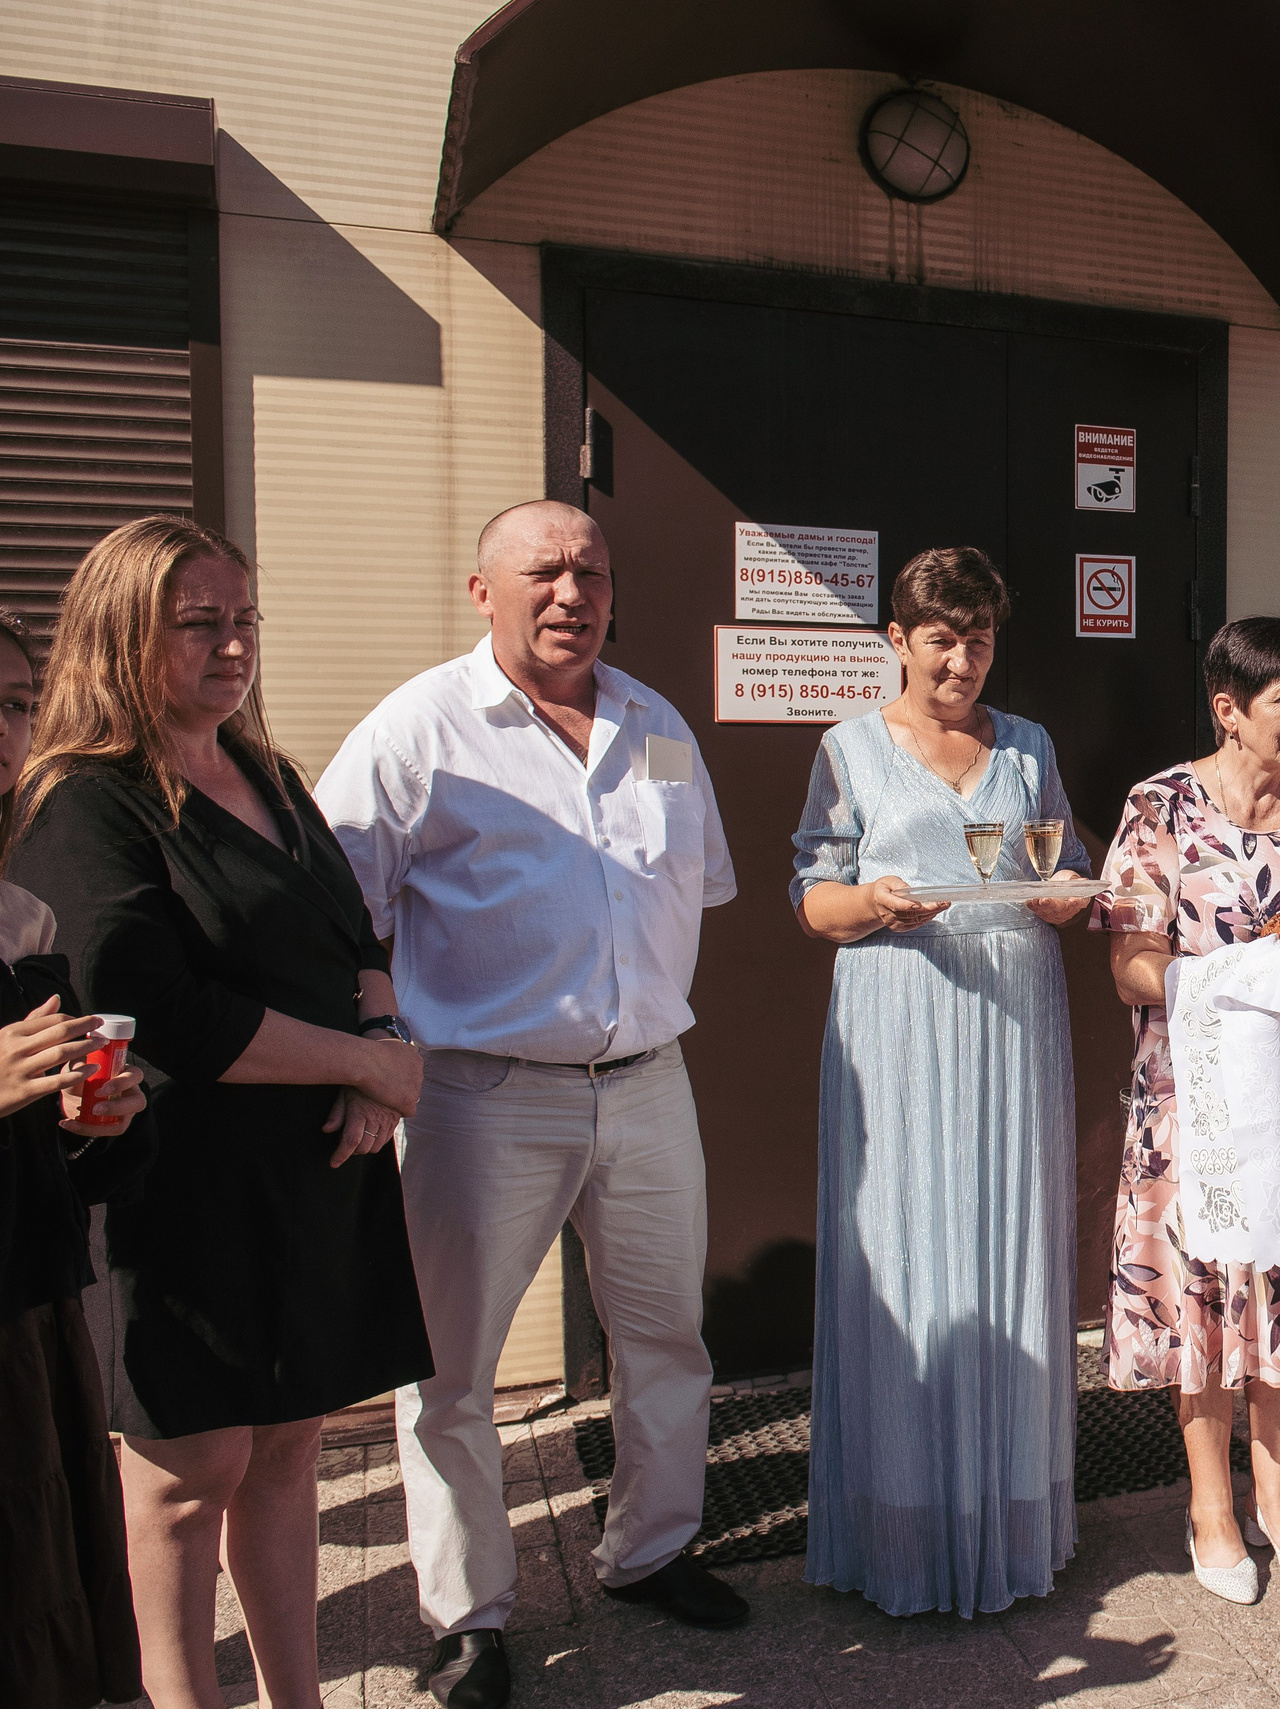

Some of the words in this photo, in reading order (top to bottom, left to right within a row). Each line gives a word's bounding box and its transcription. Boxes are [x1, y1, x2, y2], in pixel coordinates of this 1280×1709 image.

[1078, 431, 1134, 447] ВНИМАНИЕ
[1078, 452, 1134, 462] ВИДЕОНАБЛЮДЕНИЕ
[739, 528, 796, 540] Уважаемые
[797, 533, 825, 542] дамы
[836, 535, 877, 545] господа!
[744, 556, 789, 564] мероприятия
[740, 568, 875, 588] 8(915)850-45-67
[811, 592, 846, 600] составить
[829, 600, 874, 608] информацию
[1082, 618, 1095, 627] НЕ
[1096, 619, 1129, 628] КУРИТЬ
[736, 635, 766, 646] Если
[769, 636, 788, 646] Вы
[790, 638, 829, 647] хотите
[831, 640, 884, 650] получить
[731, 652, 762, 663] нашу
[765, 654, 830, 664] продукцию
[833, 655, 847, 663] на
[849, 655, 889, 665] вынос,
[741, 667, 778, 677] номер
[781, 667, 838, 679] телефона
[840, 670, 858, 678] тот
[861, 670, 880, 678] же:
[734, 683, 745, 698] 8
[750, 683, 794, 702] (915)
[799, 684, 887, 700] 850-45-67.
[786, 707, 838, 717] Звоните.
